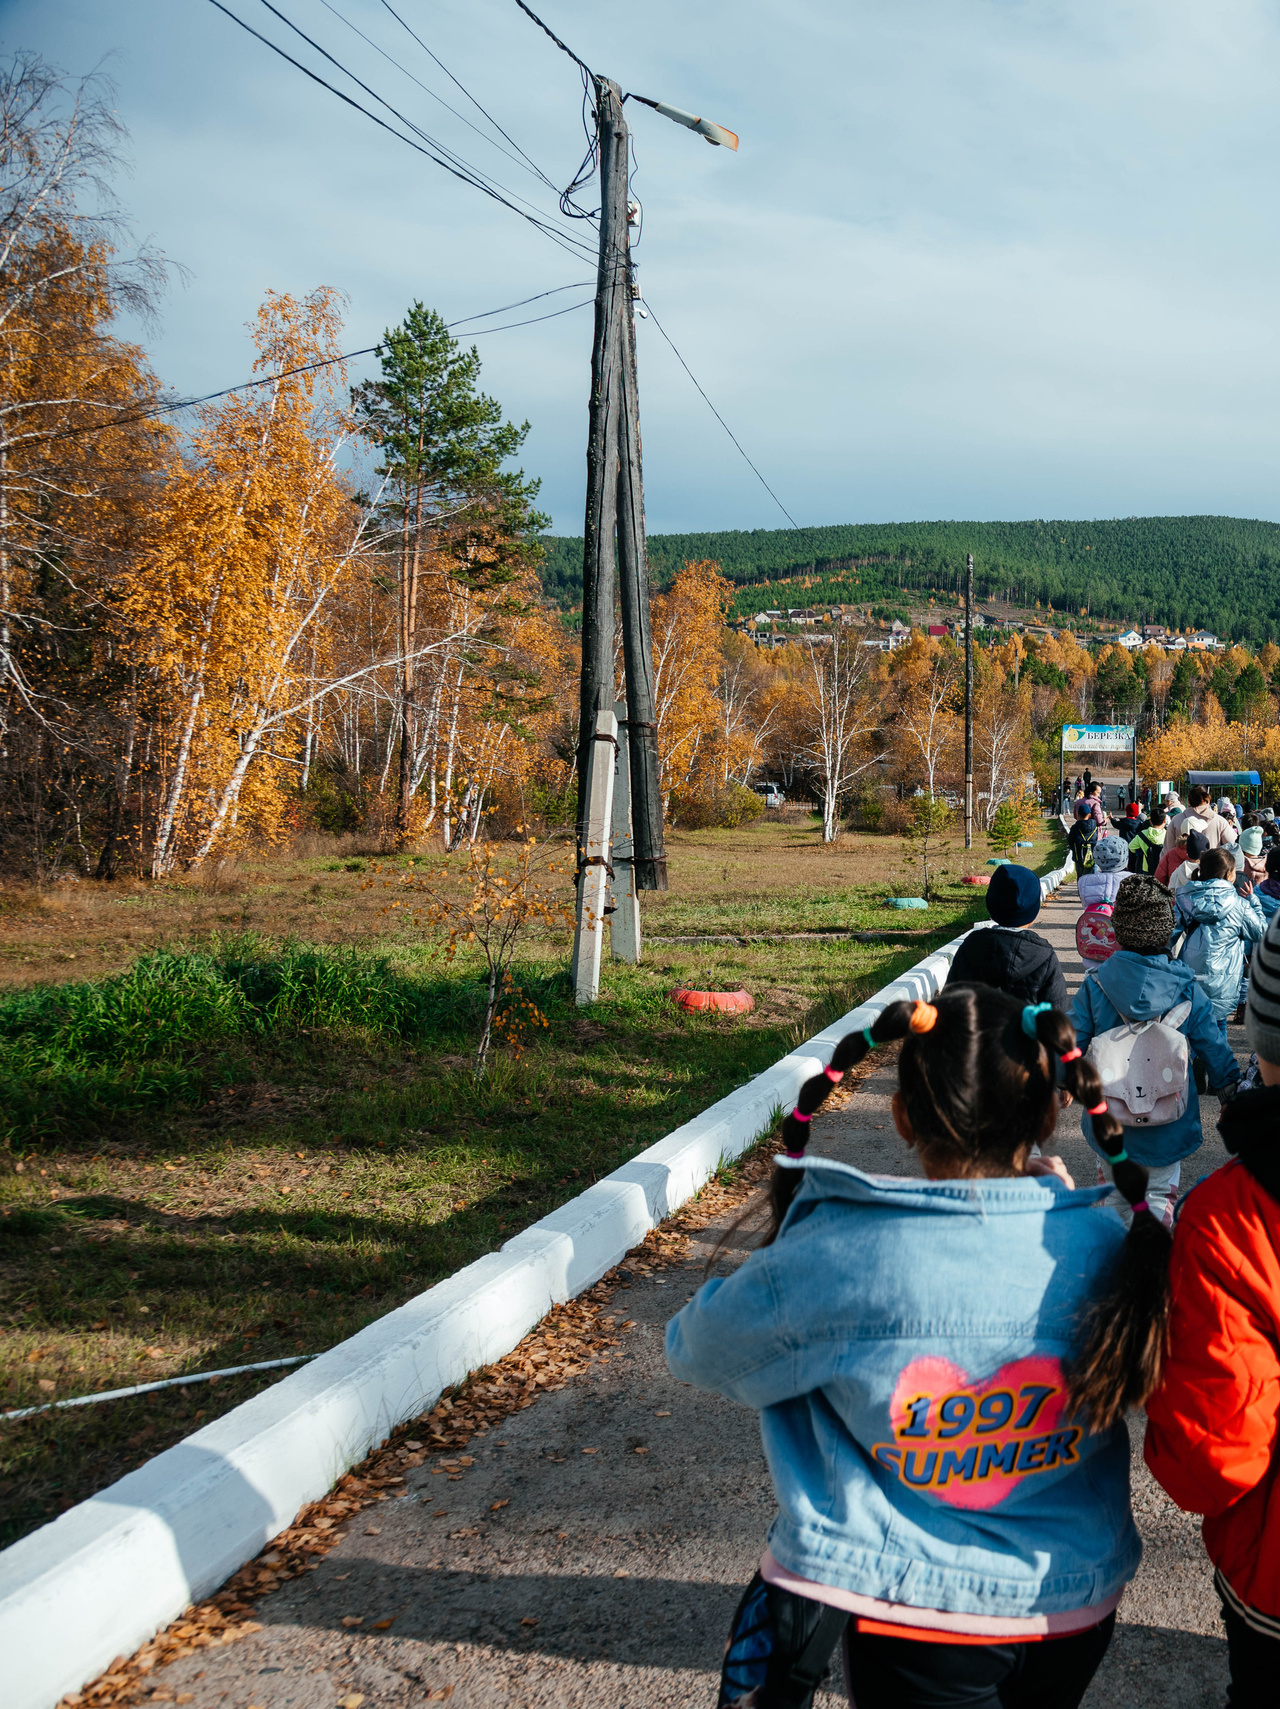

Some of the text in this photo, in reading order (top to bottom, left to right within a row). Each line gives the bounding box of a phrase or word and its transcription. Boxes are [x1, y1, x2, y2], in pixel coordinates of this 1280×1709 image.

[1087, 732, 1131, 740] БЕРЕЗКА
[898, 1382, 1061, 1441] 1997
[872, 1427, 1083, 1491] SUMMER
